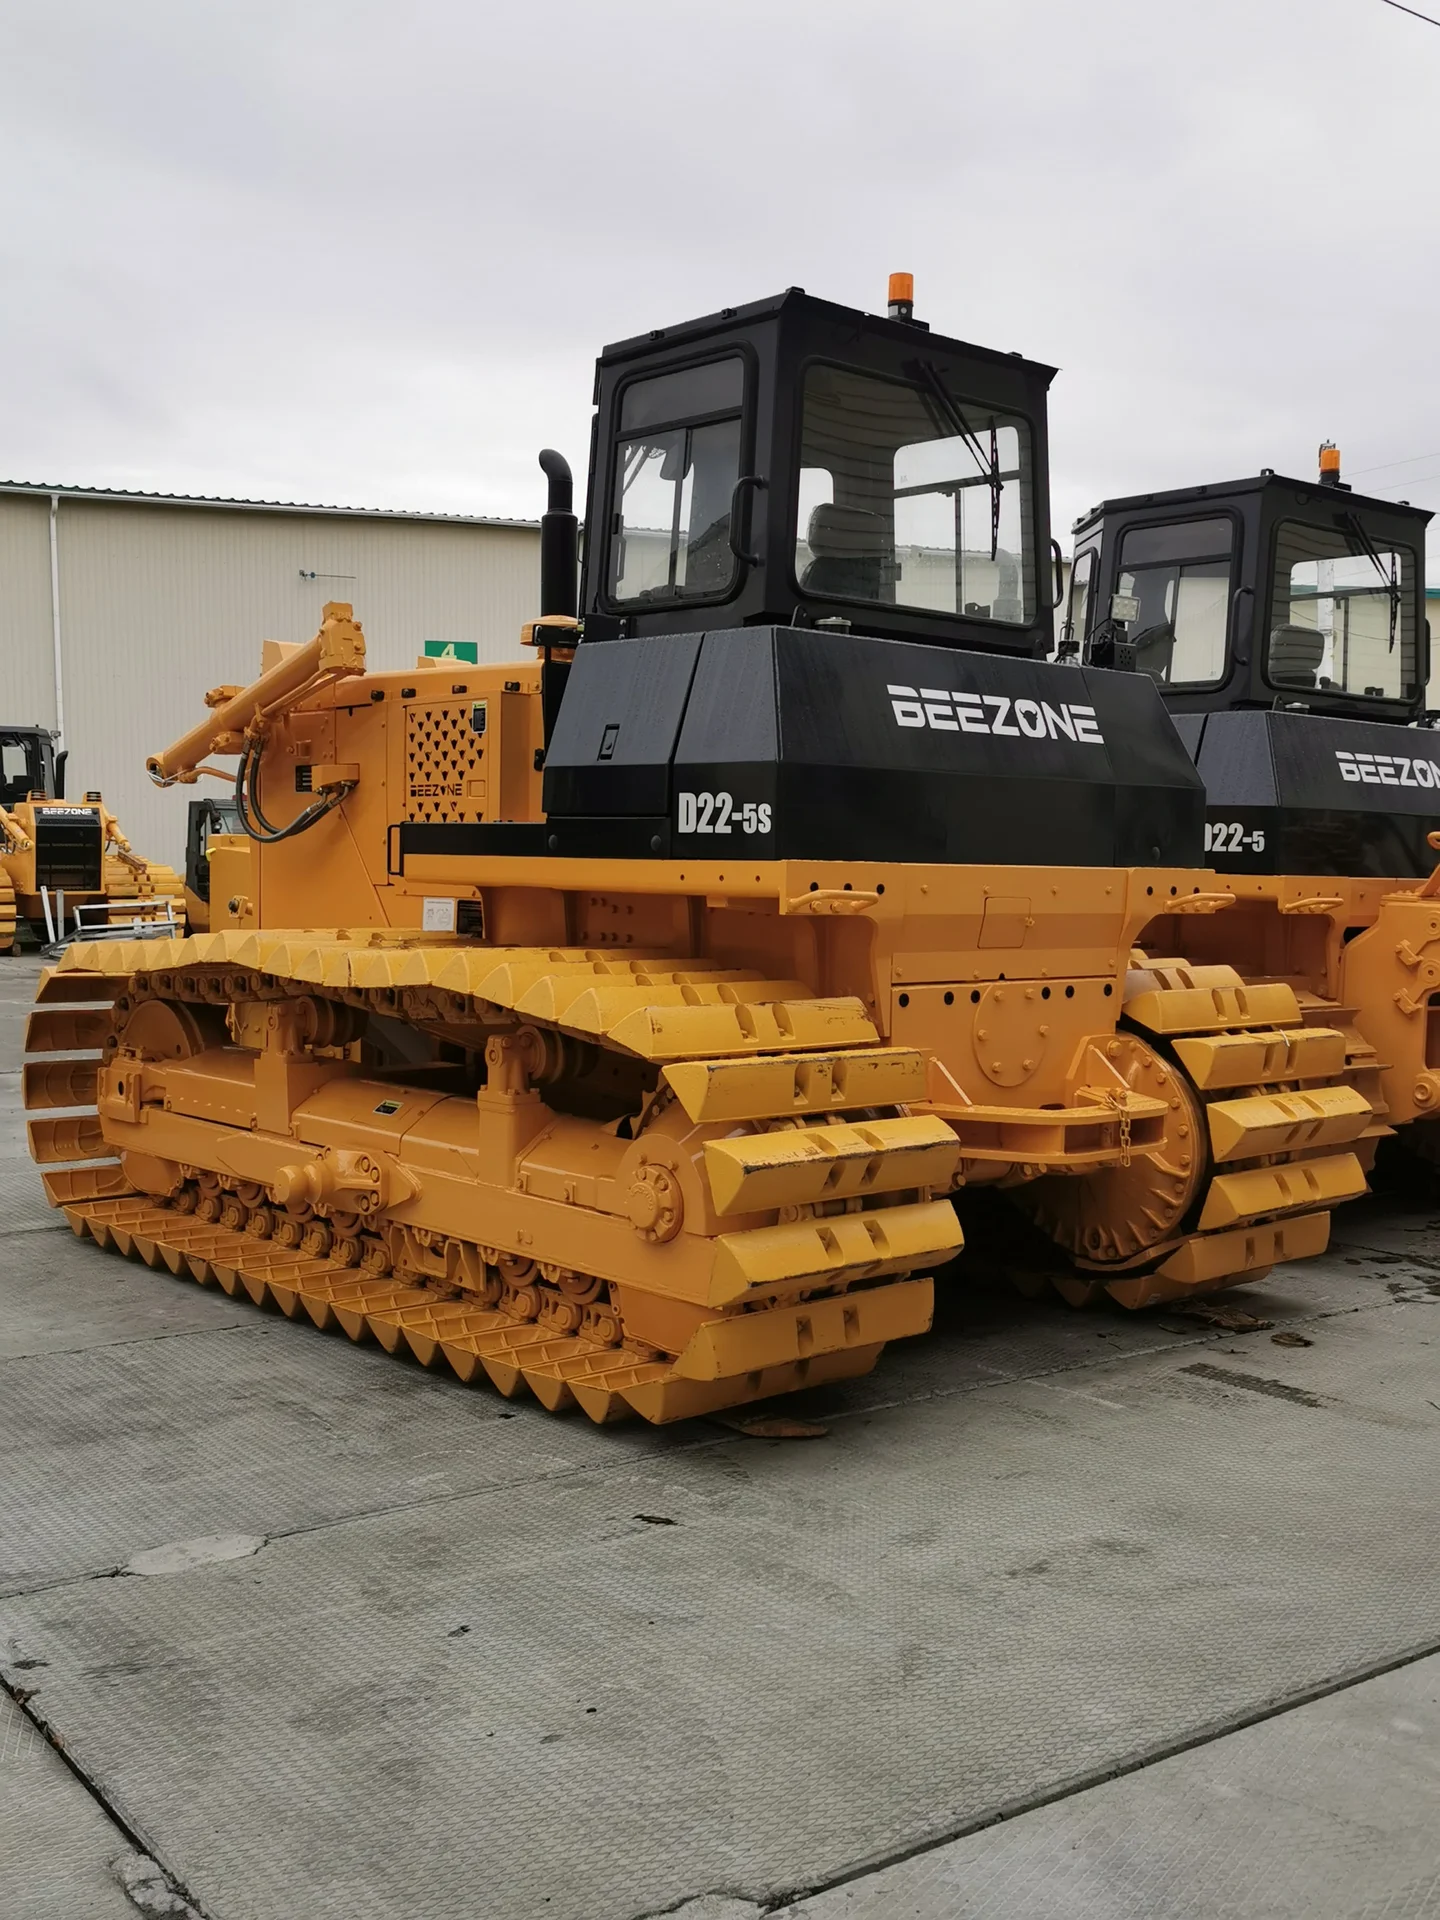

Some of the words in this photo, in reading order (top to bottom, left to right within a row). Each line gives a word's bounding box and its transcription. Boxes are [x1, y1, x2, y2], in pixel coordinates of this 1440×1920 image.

[441, 643, 457, 659] 4
[886, 684, 1105, 744] BEEZONE
[42, 807, 92, 816] BEEZONE
[678, 792, 772, 834] D22-5S
